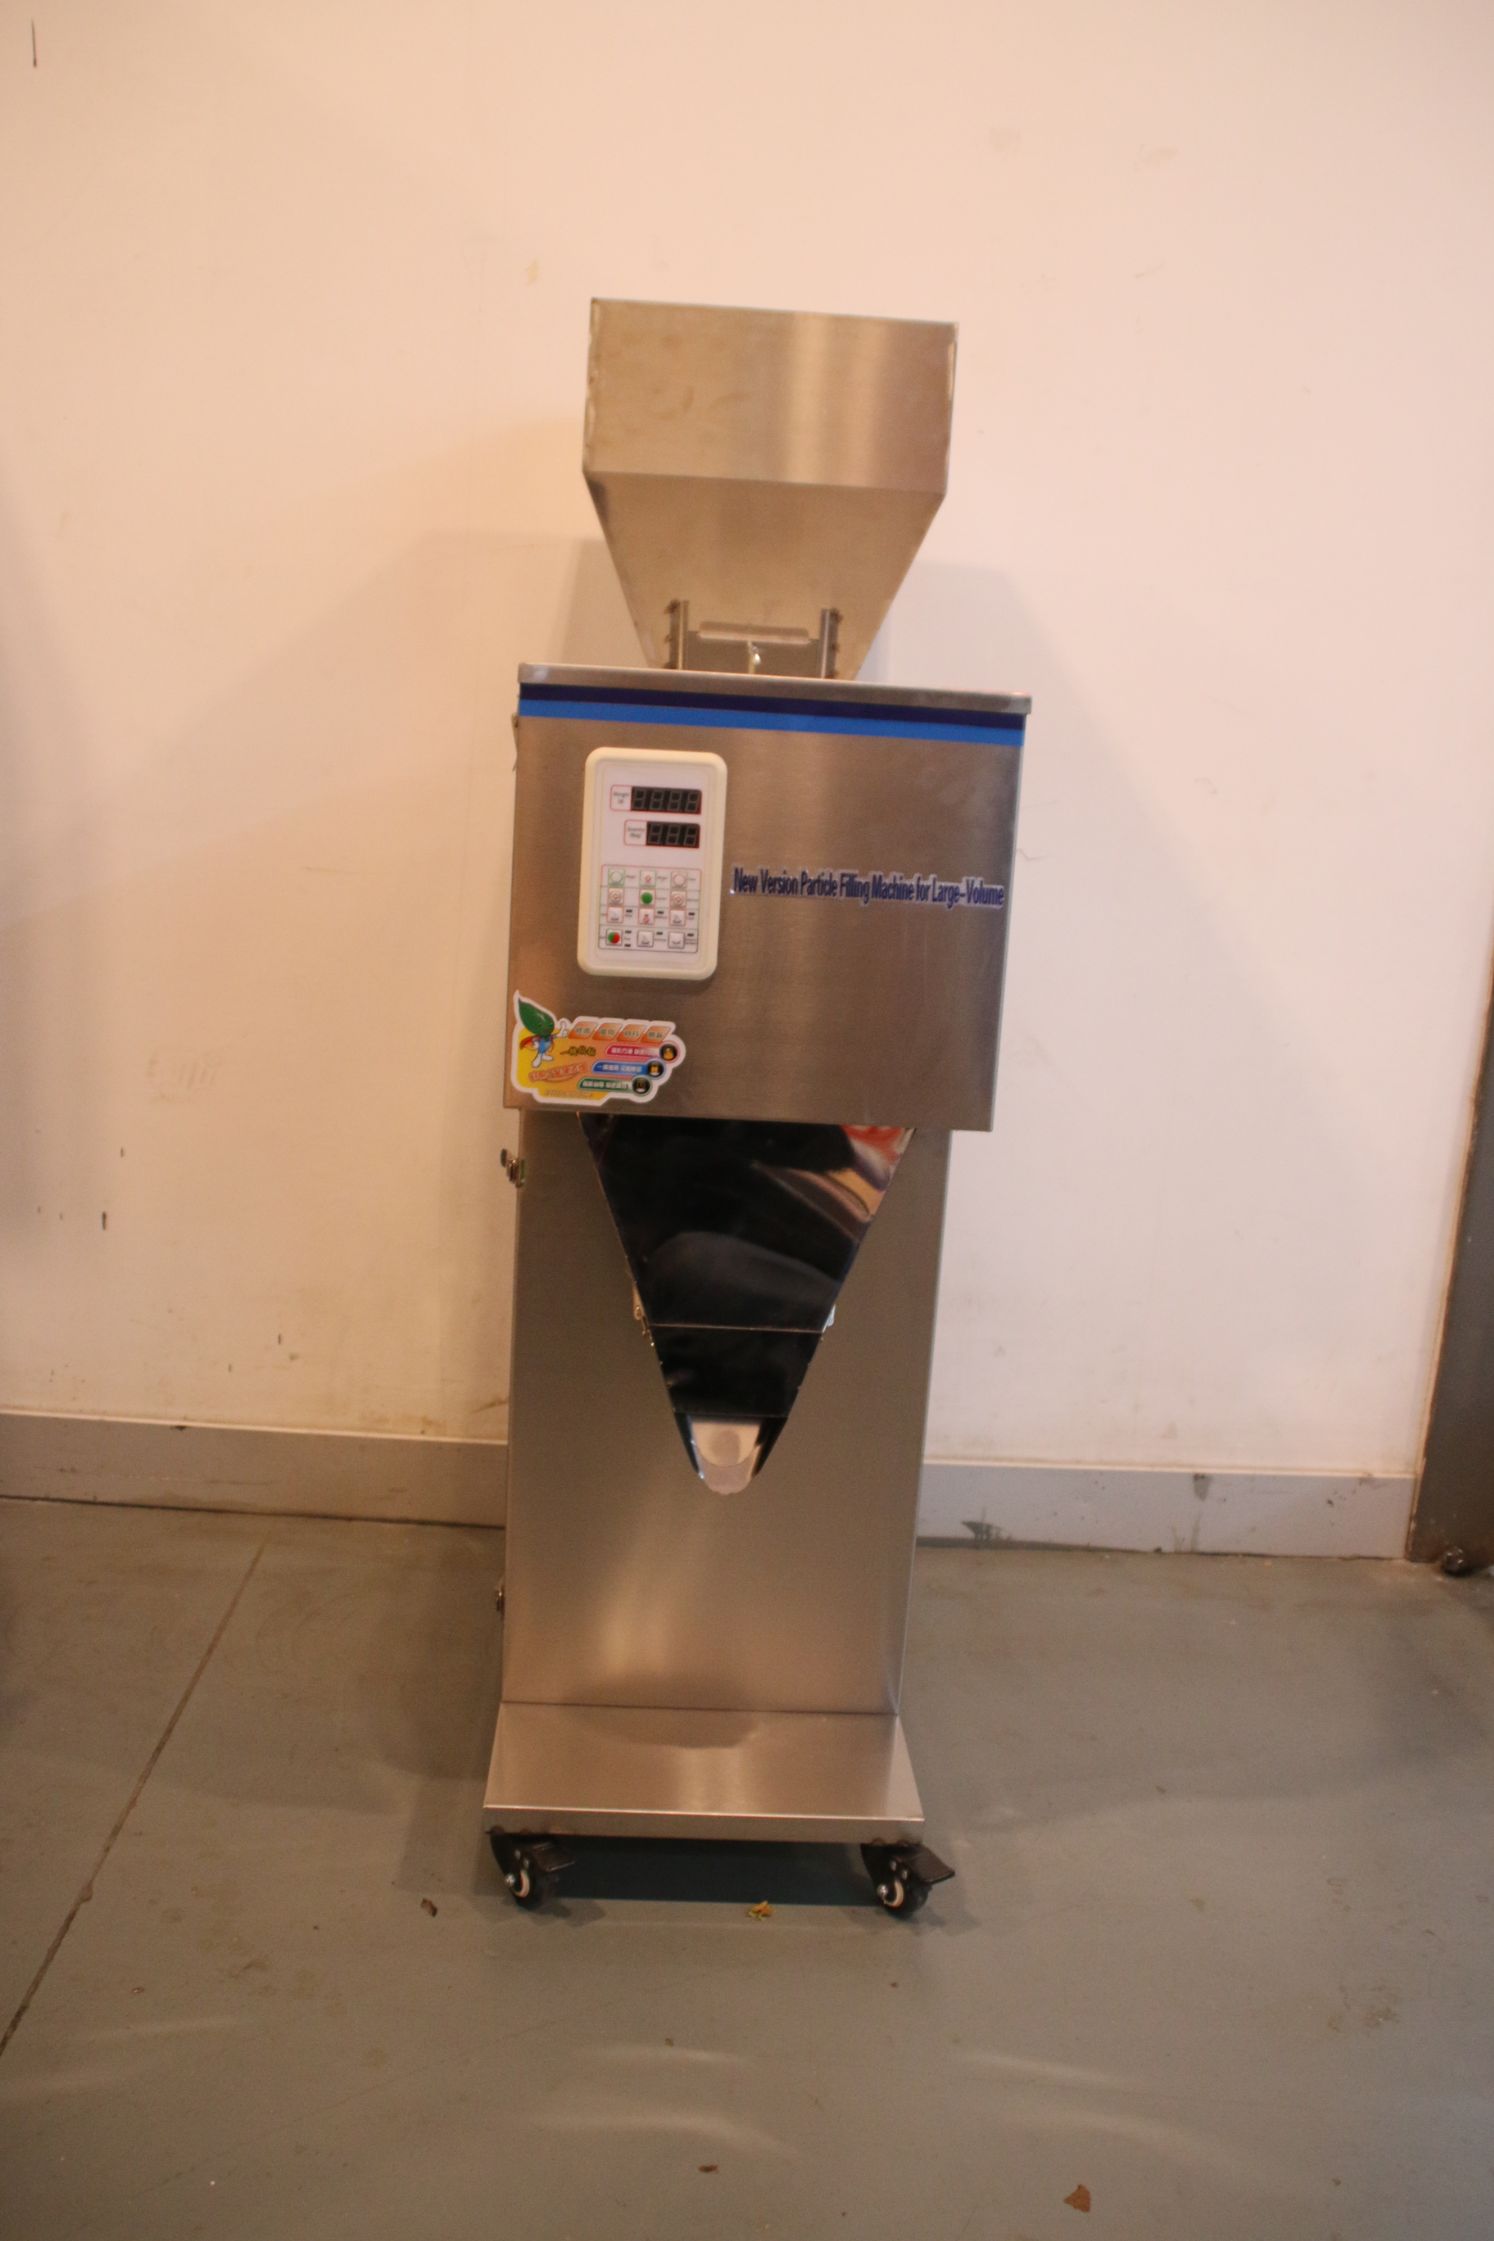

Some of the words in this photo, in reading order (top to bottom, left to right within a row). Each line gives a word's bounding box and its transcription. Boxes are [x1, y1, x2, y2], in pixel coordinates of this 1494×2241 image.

[734, 867, 758, 894] New
[760, 867, 799, 896] Version
[800, 870, 838, 897] Particle
[840, 872, 870, 904] Filling
[871, 874, 915, 900] Machine
[916, 876, 930, 901] for
[932, 876, 1004, 908] Large-Volume
